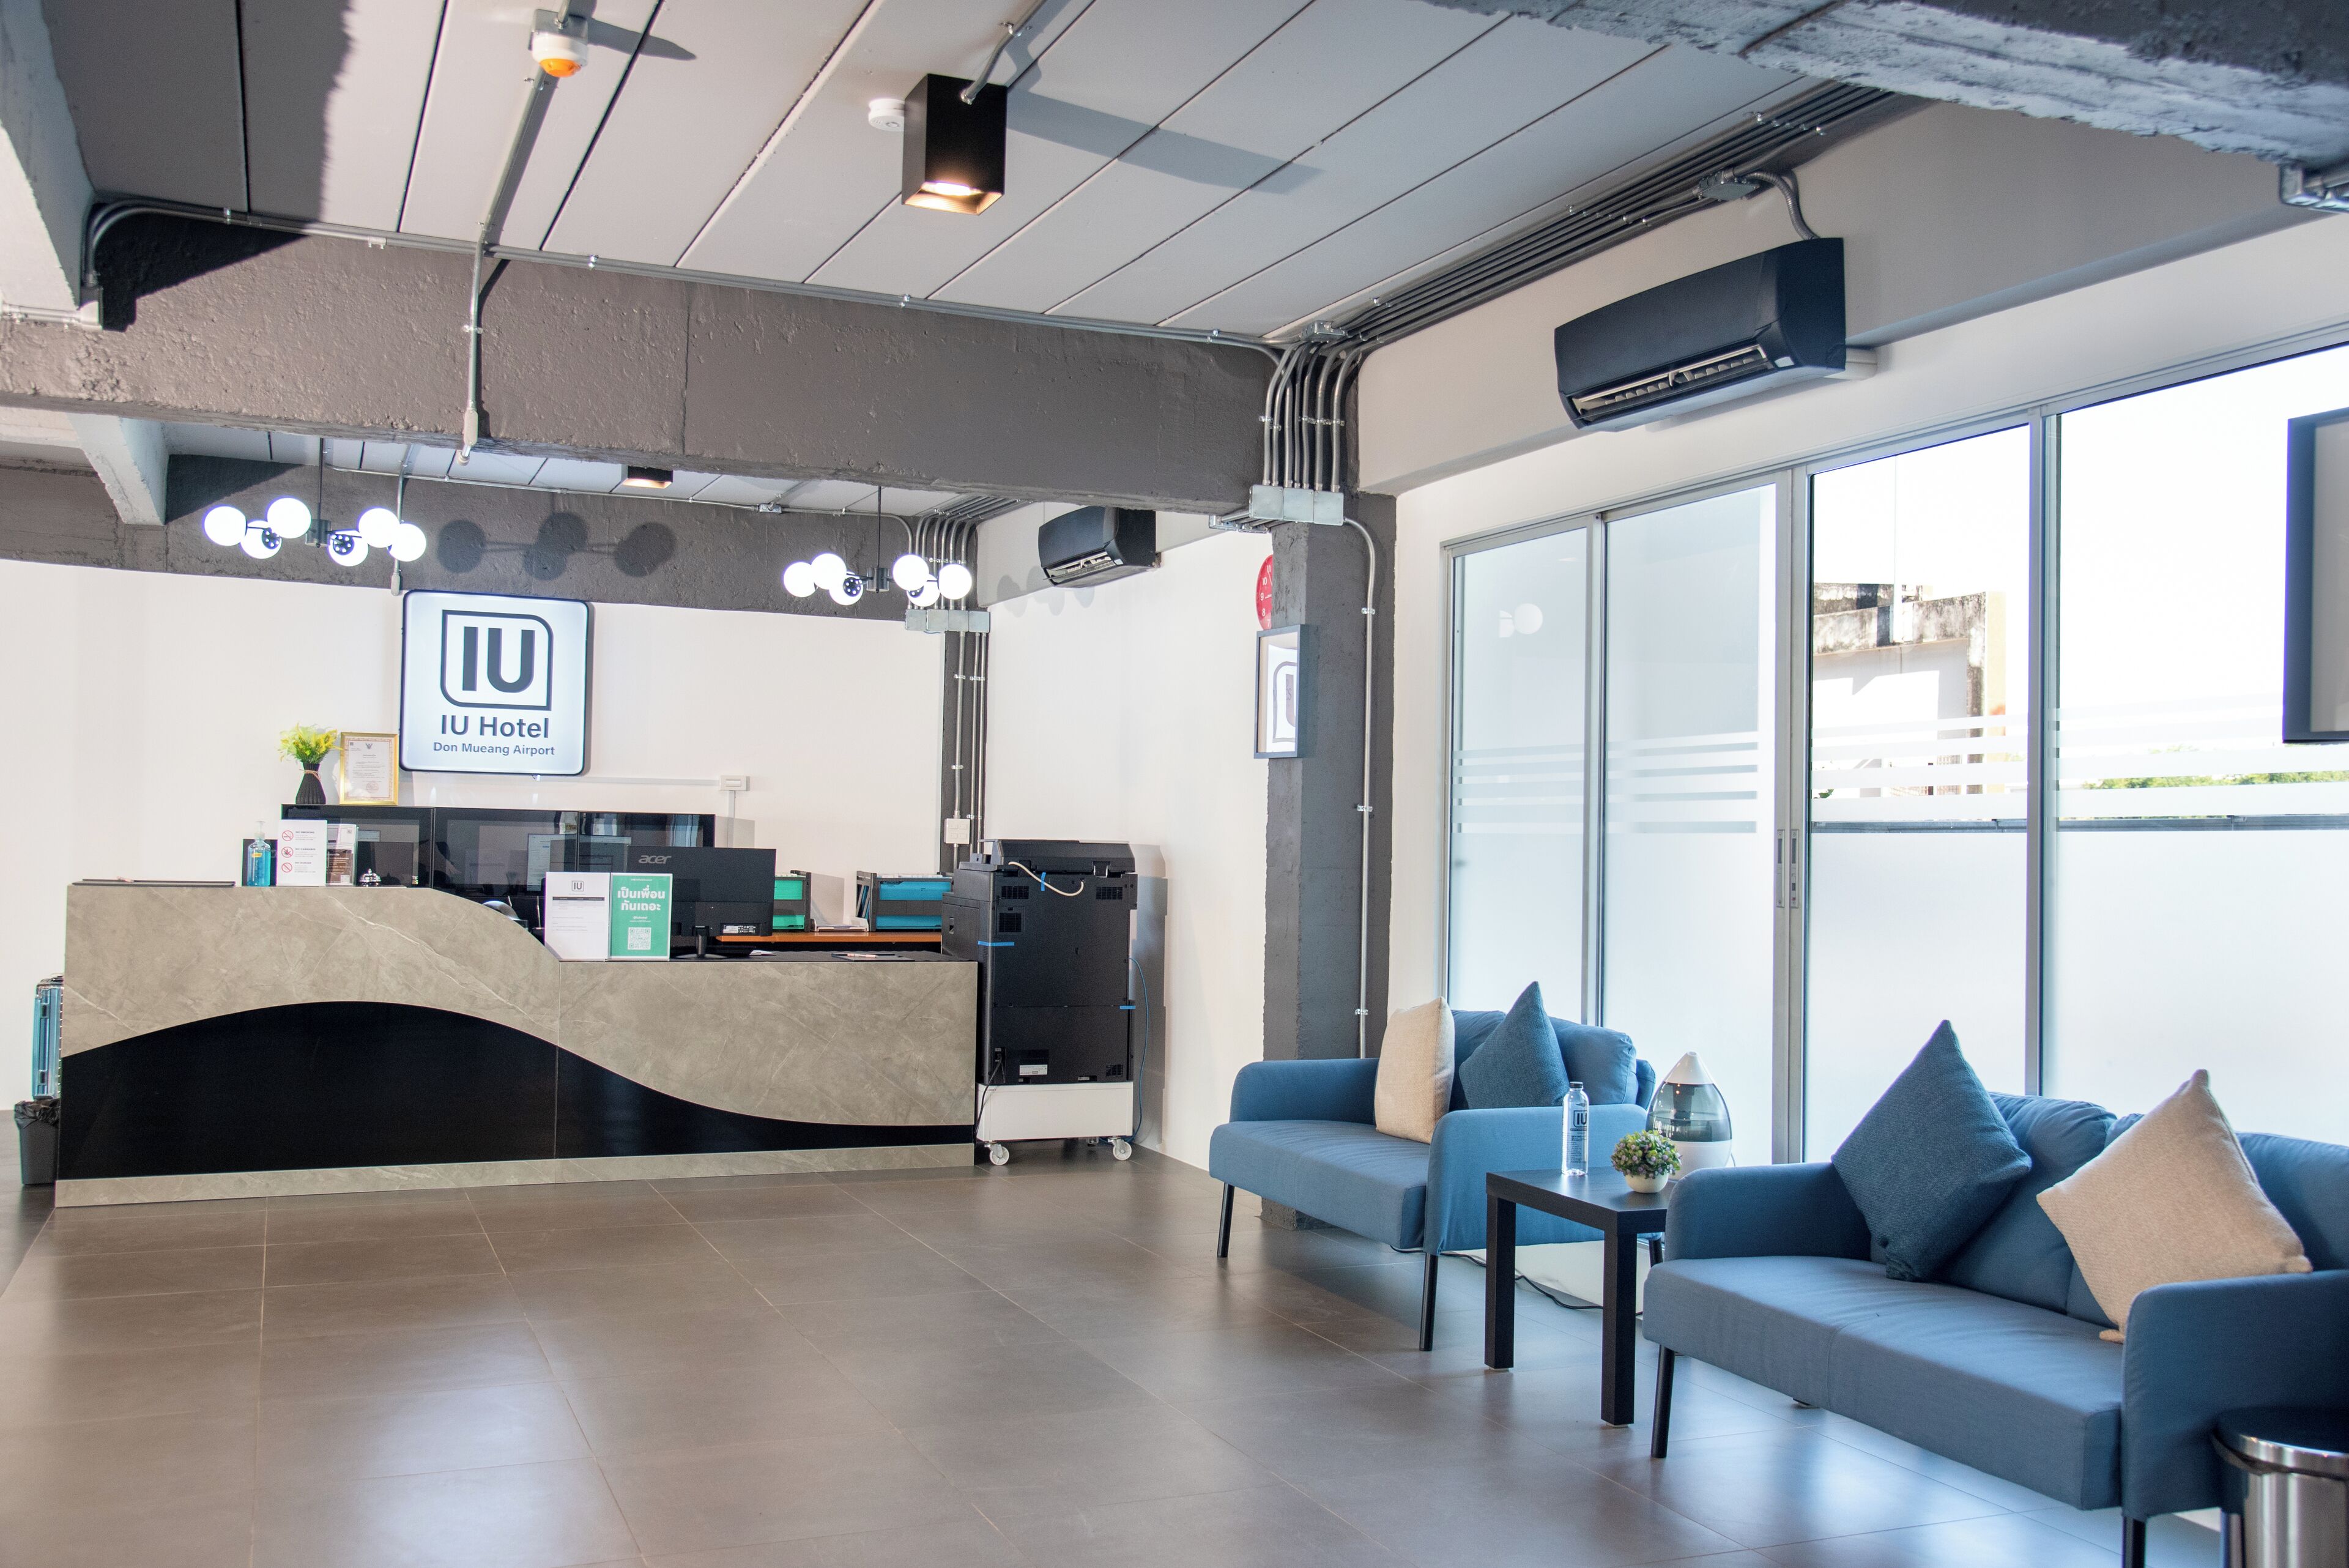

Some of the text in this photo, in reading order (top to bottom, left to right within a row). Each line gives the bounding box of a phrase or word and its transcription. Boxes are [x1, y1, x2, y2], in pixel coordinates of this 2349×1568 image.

[1266, 565, 1271, 573] 11
[1262, 577, 1267, 585] 10
[1260, 592, 1264, 601] 9
[1262, 608, 1266, 617] 8
[1267, 619, 1271, 628] 7
[462, 626, 535, 693] IU
[441, 715, 549, 738] IU Hotel
[433, 741, 555, 757] Don Mueang Airport
[638, 855, 672, 864] acer
[617, 885, 666, 899] เป็นเพื่อน
[621, 901, 661, 911] กันเถอะ
[1576, 1113, 1587, 1125] IU
